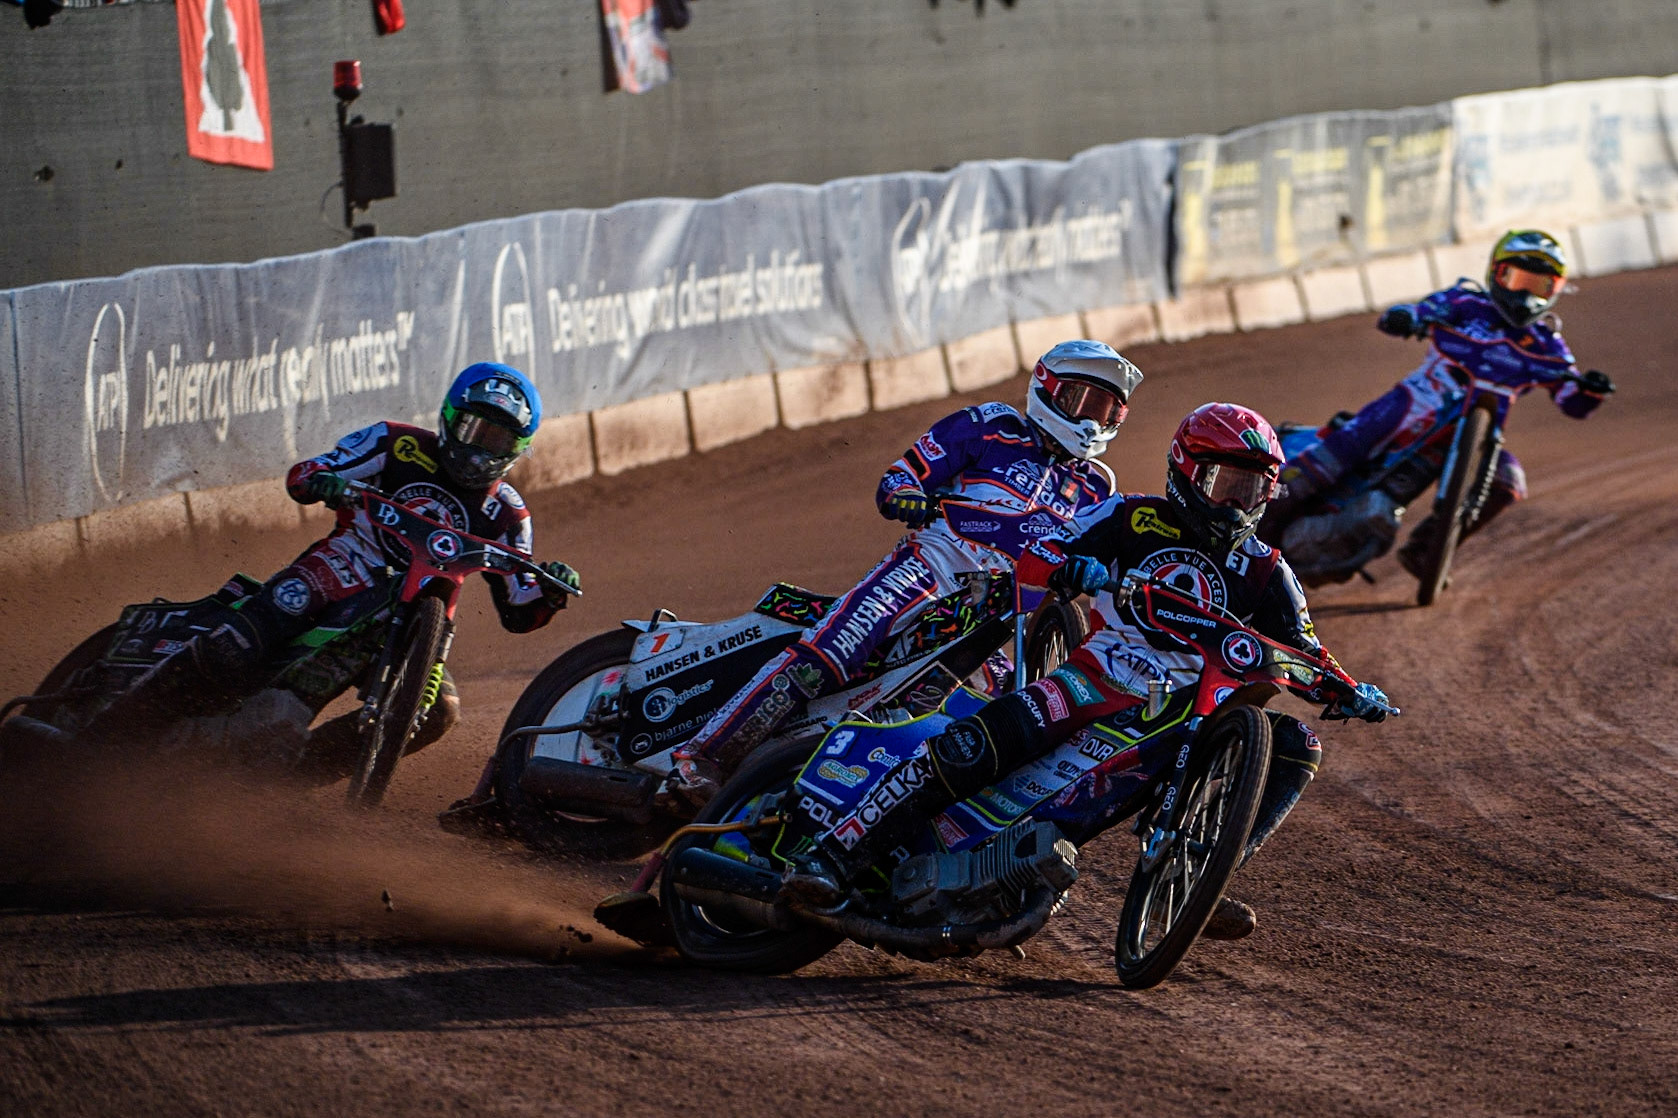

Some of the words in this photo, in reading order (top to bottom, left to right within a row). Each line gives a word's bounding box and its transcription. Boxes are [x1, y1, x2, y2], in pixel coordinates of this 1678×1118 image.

[143, 341, 231, 443] Delivering
[233, 337, 279, 415] what
[279, 320, 332, 423] really
[400, 487, 433, 501] BELLE
[436, 491, 457, 513] VUE
[959, 520, 994, 528] FASTRACK
[1228, 551, 1244, 572] 3
[1143, 552, 1179, 574] BELLE
[1184, 553, 1208, 571] VUE
[1206, 572, 1224, 604] ACES
[832, 595, 892, 660] HANSEN
[1156, 608, 1218, 629] POLCOPPER
[644, 650, 701, 682] HANSEN
[703, 645, 717, 659] &
[717, 624, 764, 655] KRUSE
[650, 632, 670, 654] 1
[665, 679, 714, 708] logistics
[1017, 690, 1047, 729] DOCUFY
[653, 718, 695, 745] bjarne
[825, 730, 856, 756] 3
[1082, 738, 1115, 761] OVR
[1175, 744, 1190, 770] GEO
[857, 758, 935, 828] CELKA
[1161, 787, 1177, 812] GEO
